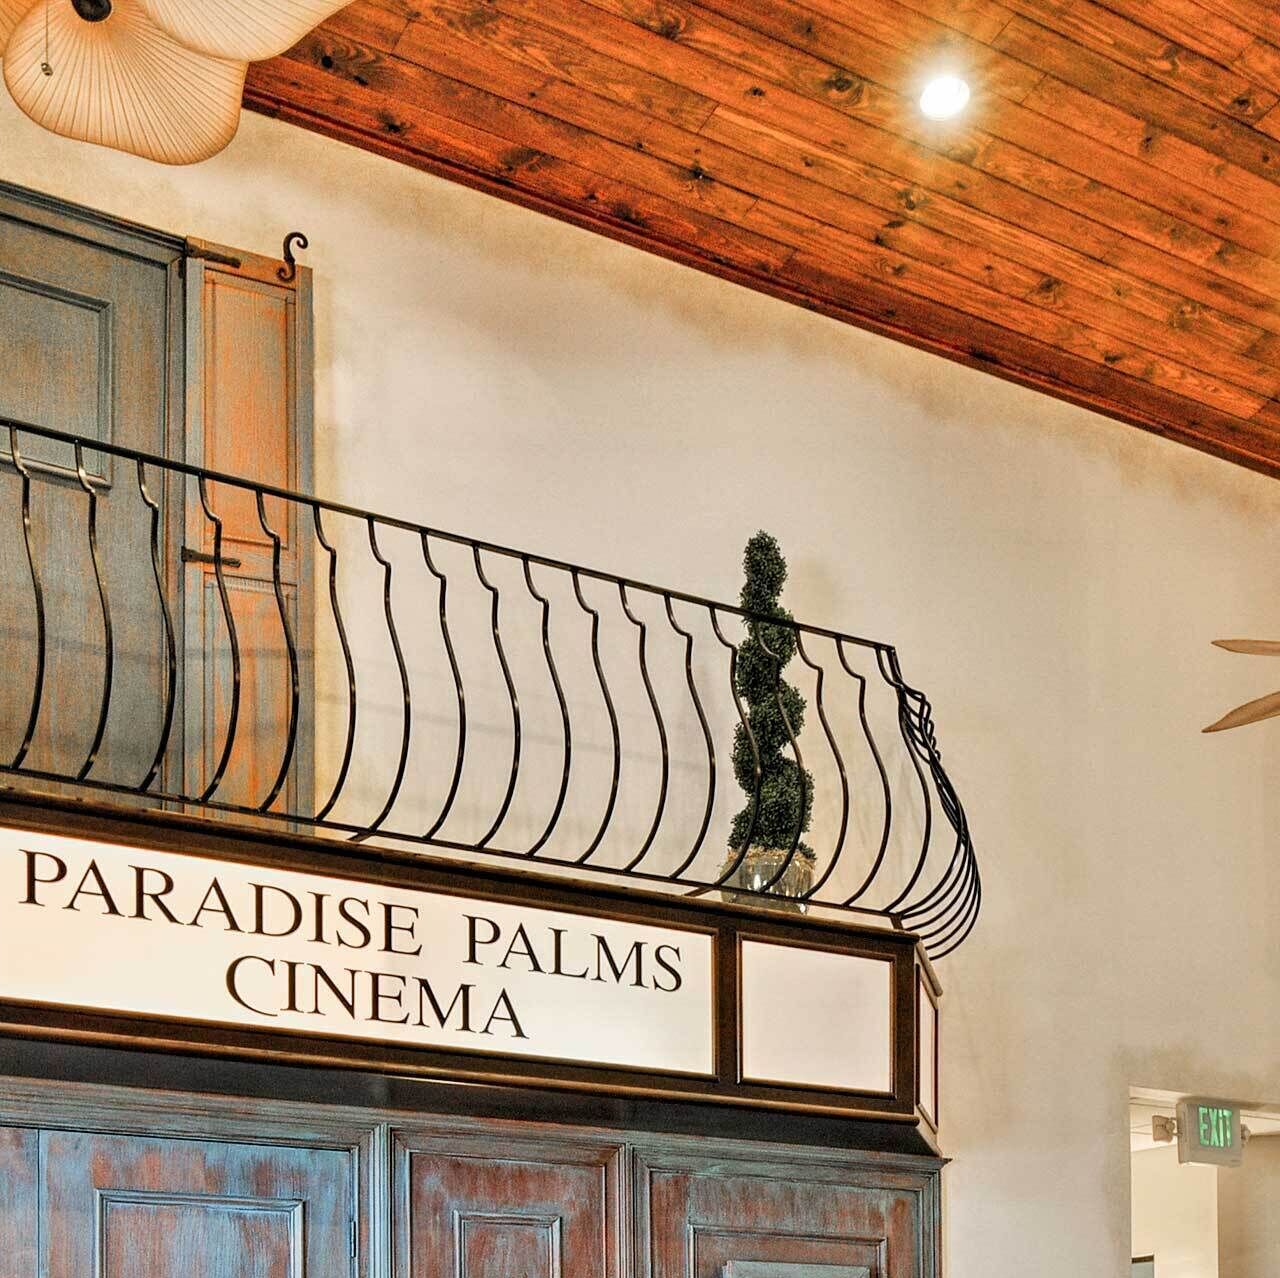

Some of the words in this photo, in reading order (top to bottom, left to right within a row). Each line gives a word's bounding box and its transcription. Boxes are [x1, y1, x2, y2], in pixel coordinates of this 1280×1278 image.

[19, 849, 421, 956] PARADISE
[462, 915, 682, 992] PALMS
[226, 956, 529, 1039] CINEMA
[1199, 1107, 1232, 1148] EXIT
